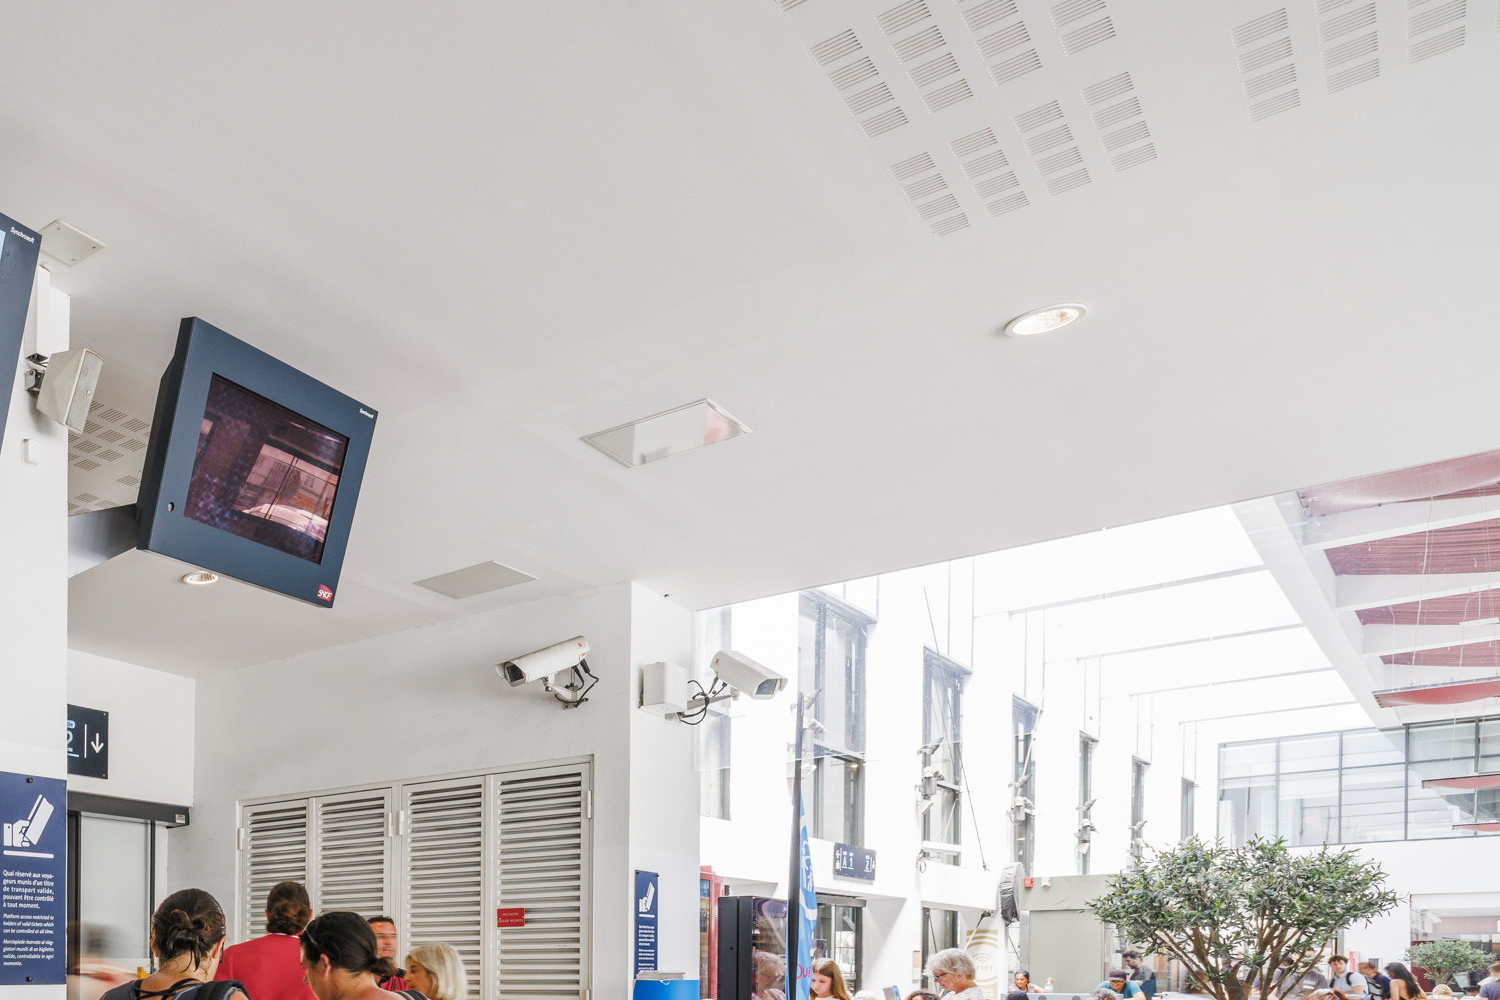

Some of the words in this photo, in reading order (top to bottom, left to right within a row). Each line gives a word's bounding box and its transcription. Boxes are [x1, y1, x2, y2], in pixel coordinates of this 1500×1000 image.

[317, 589, 332, 599] SNCF
[843, 856, 847, 867] A
[865, 860, 870, 870] 2
